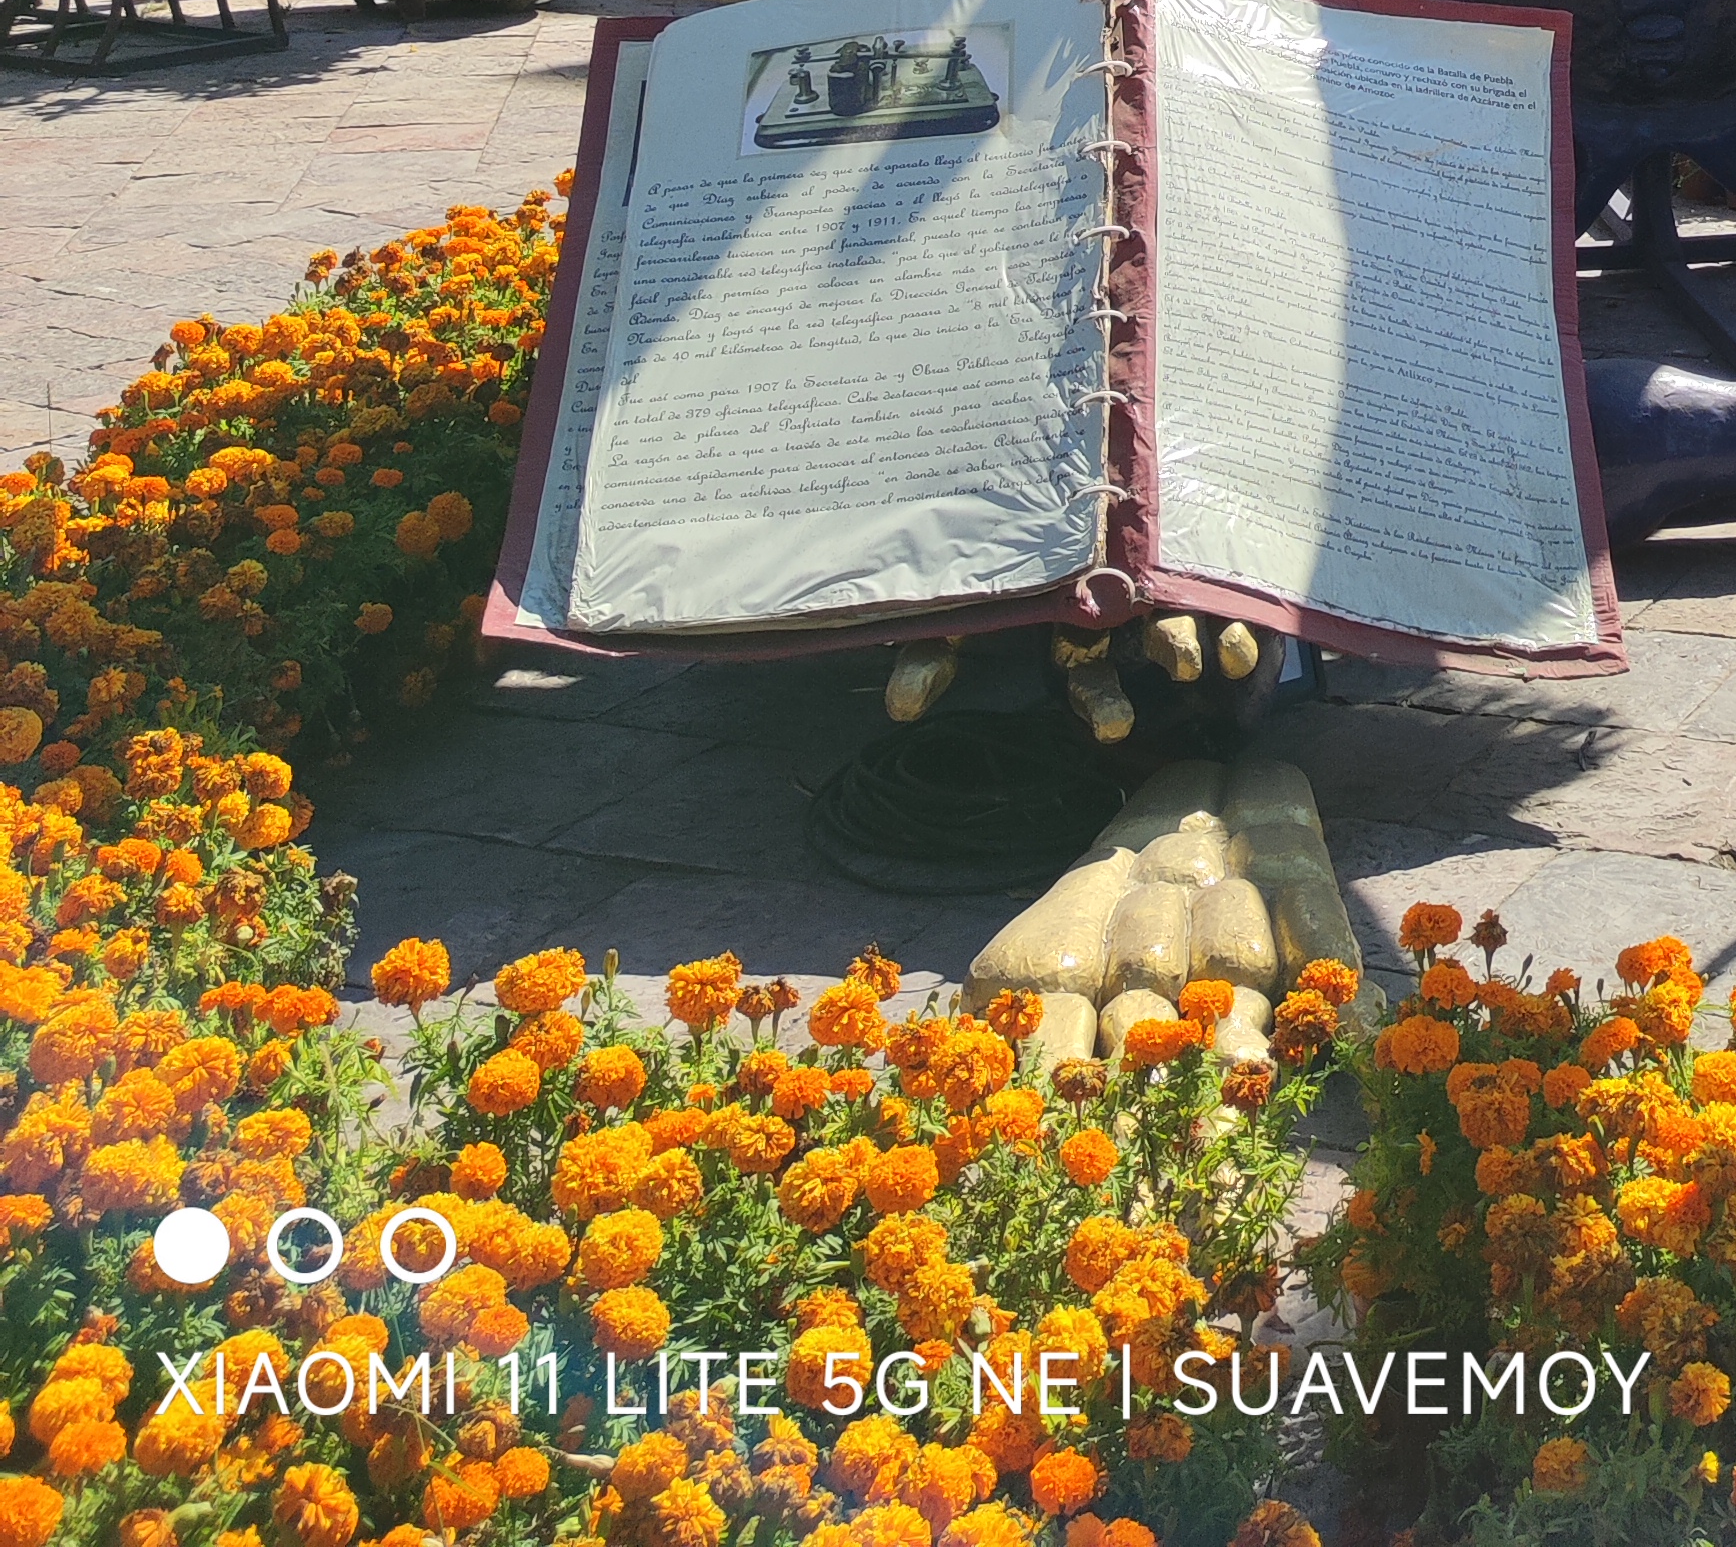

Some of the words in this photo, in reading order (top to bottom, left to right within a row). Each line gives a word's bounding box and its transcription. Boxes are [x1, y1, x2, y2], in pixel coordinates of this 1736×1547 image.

[1344, 82, 1356, 90] de
[1404, 83, 1412, 92] la
[1416, 85, 1455, 99] ladrillera
[1458, 93, 1468, 101] de
[1470, 95, 1510, 109] Azcárate
[1528, 101, 1536, 109] el
[1412, 76, 1448, 87] rechazó
[1483, 85, 1516, 97] brigada
[1518, 89, 1527, 97] el
[1413, 65, 1424, 73] de
[1427, 66, 1434, 74] la
[1438, 67, 1467, 79] Batalla
[1470, 73, 1481, 81] de
[1484, 74, 1512, 85] Puebla
[661, 185, 694, 198] pesar
[758, 173, 804, 186] primera
[883, 158, 929, 174] aparato
[934, 155, 962, 169] llegó
[703, 190, 734, 207] Díaz
[746, 188, 788, 201] subiera
[822, 185, 859, 199] poder,
[896, 176, 940, 187] acuerdo
[1006, 155, 1065, 176] Secretaría
[640, 233, 695, 250] telegrafía
[702, 228, 772, 241] inalámbrica
[779, 227, 808, 235] entre
[816, 221, 846, 232] 1907
[868, 217, 901, 227] 1911.
[933, 208, 966, 224] aquel
[971, 209, 1009, 219] tiempo
[1038, 193, 1088, 210] empresas
[642, 215, 736, 229] Comunicaciones
[763, 205, 833, 219] Transportes
[844, 201, 886, 215] gracias
[932, 192, 960, 205] llegó
[990, 177, 1072, 196] radiotelegrafía
[634, 251, 720, 271] ferrocarrileras
[800, 239, 835, 257] papel
[839, 231, 916, 253] fundamental,
[921, 230, 960, 245] puesto
[1012, 215, 1062, 231] contaban
[661, 268, 733, 283] considerable
[761, 261, 822, 278] telegráfica
[980, 241, 1030, 258] gobierno
[628, 292, 660, 310] fácil
[665, 289, 712, 307] pedirles
[776, 285, 807, 297] para
[817, 277, 859, 288] colocar
[894, 267, 942, 281] alambre
[629, 312, 680, 325] Además,
[689, 308, 720, 323] Díaz
[746, 302, 792, 315] encargó
[818, 299, 864, 311] mejorar
[890, 288, 948, 301] Dirección
[955, 282, 1002, 293] General
[627, 329, 701, 345] Nacionales
[722, 325, 753, 339] logró
[832, 311, 893, 329] telegráfica
[898, 310, 941, 324] pasara
[809, 335, 862, 351] longitud,
[936, 324, 968, 334] inicio
[673, 392, 704, 400] como
[708, 388, 740, 401] para
[749, 382, 779, 393] 1907
[804, 375, 868, 388] Secretaría
[912, 364, 950, 376] Obras
[955, 356, 1009, 371] Públicas
[1397, 367, 1433, 384] Atlixco
[634, 411, 666, 424] total
[715, 405, 763, 421] oficinas
[768, 397, 841, 415] telegráficas.
[848, 391, 878, 403] Cabe
[985, 379, 1014, 387] como
[694, 426, 739, 443] pilares
[779, 417, 840, 434] Porfiriato
[851, 410, 900, 424] también
[910, 405, 943, 417] sirvió
[951, 403, 981, 417] para
[990, 392, 1033, 406] acabar
[634, 454, 670, 468] razón
[786, 440, 821, 451] través
[876, 428, 910, 442] medio
[940, 415, 1030, 433] revolucionarios
[601, 499, 655, 510] conserva
[740, 484, 792, 498] archivos
[799, 476, 870, 495] telegráficos
[905, 468, 940, 480] donde
[966, 455, 1003, 472] daban
[604, 474, 682, 489] comunicarse
[687, 467, 764, 485] rápidamente
[767, 465, 800, 479] para
[806, 460, 856, 470] derrocar
[878, 451, 930, 462] entonces
[935, 441, 987, 455] dictador.
[690, 513, 740, 523] noticias
[805, 500, 850, 513] sucedía
[896, 487, 968, 503] movimiento
